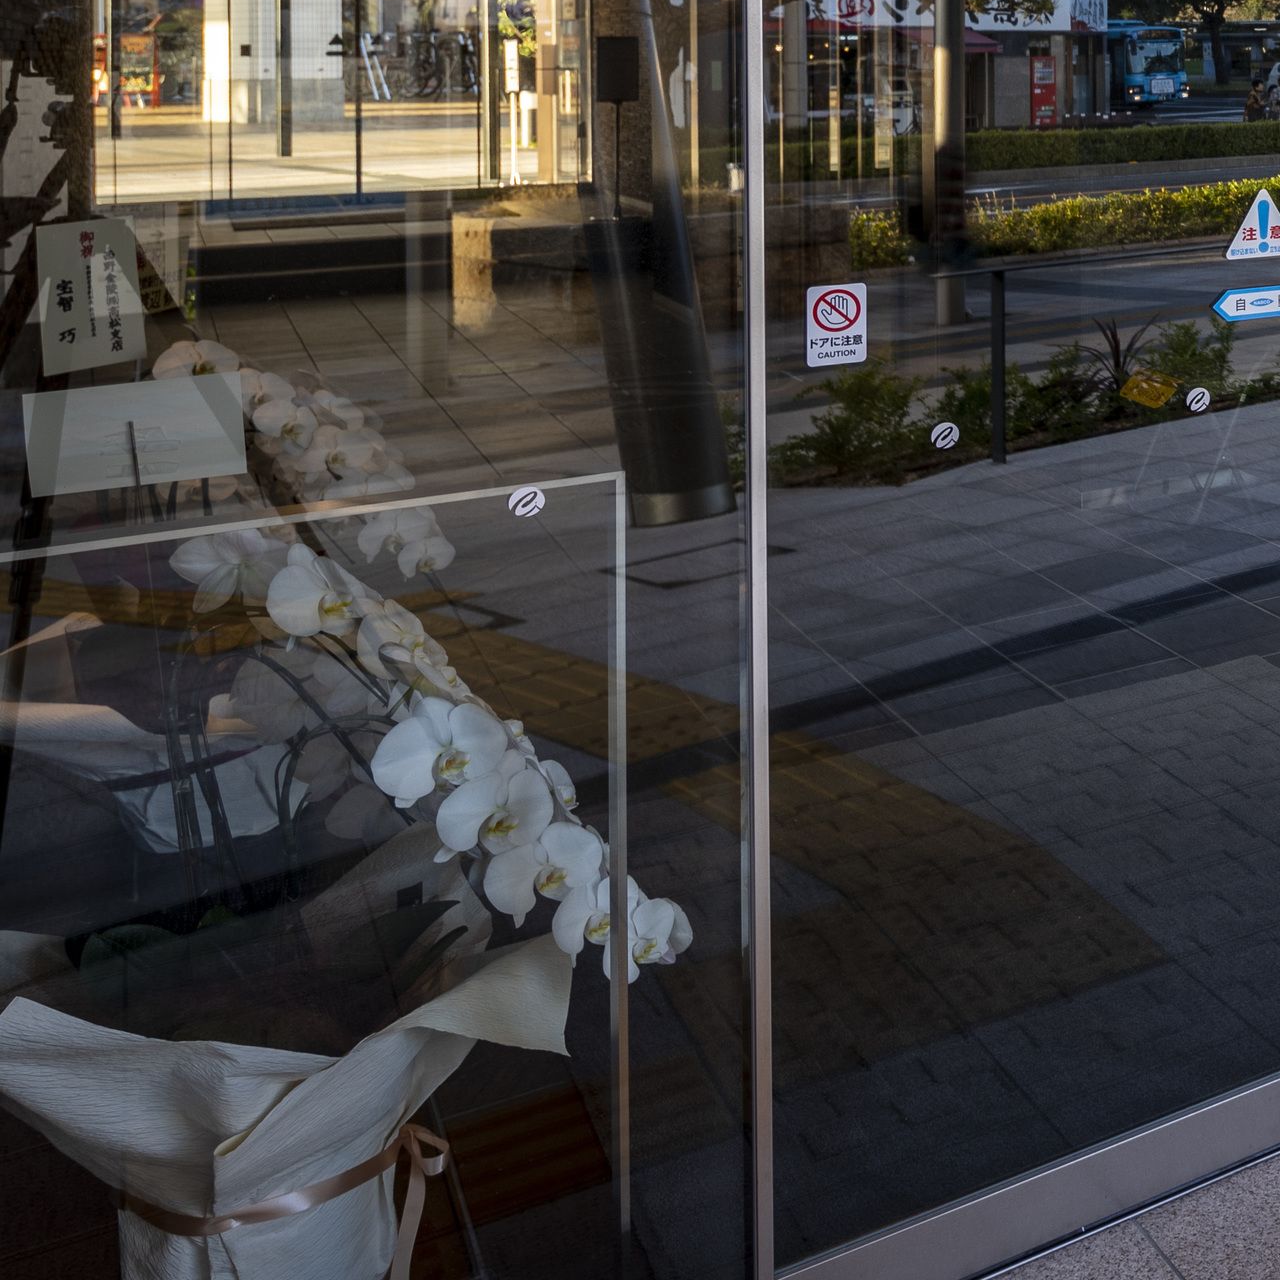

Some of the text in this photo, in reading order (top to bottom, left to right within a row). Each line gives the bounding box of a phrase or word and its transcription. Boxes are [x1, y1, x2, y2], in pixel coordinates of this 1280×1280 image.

[810, 334, 863, 349] ドアに注意
[817, 349, 856, 359] CAUTION
